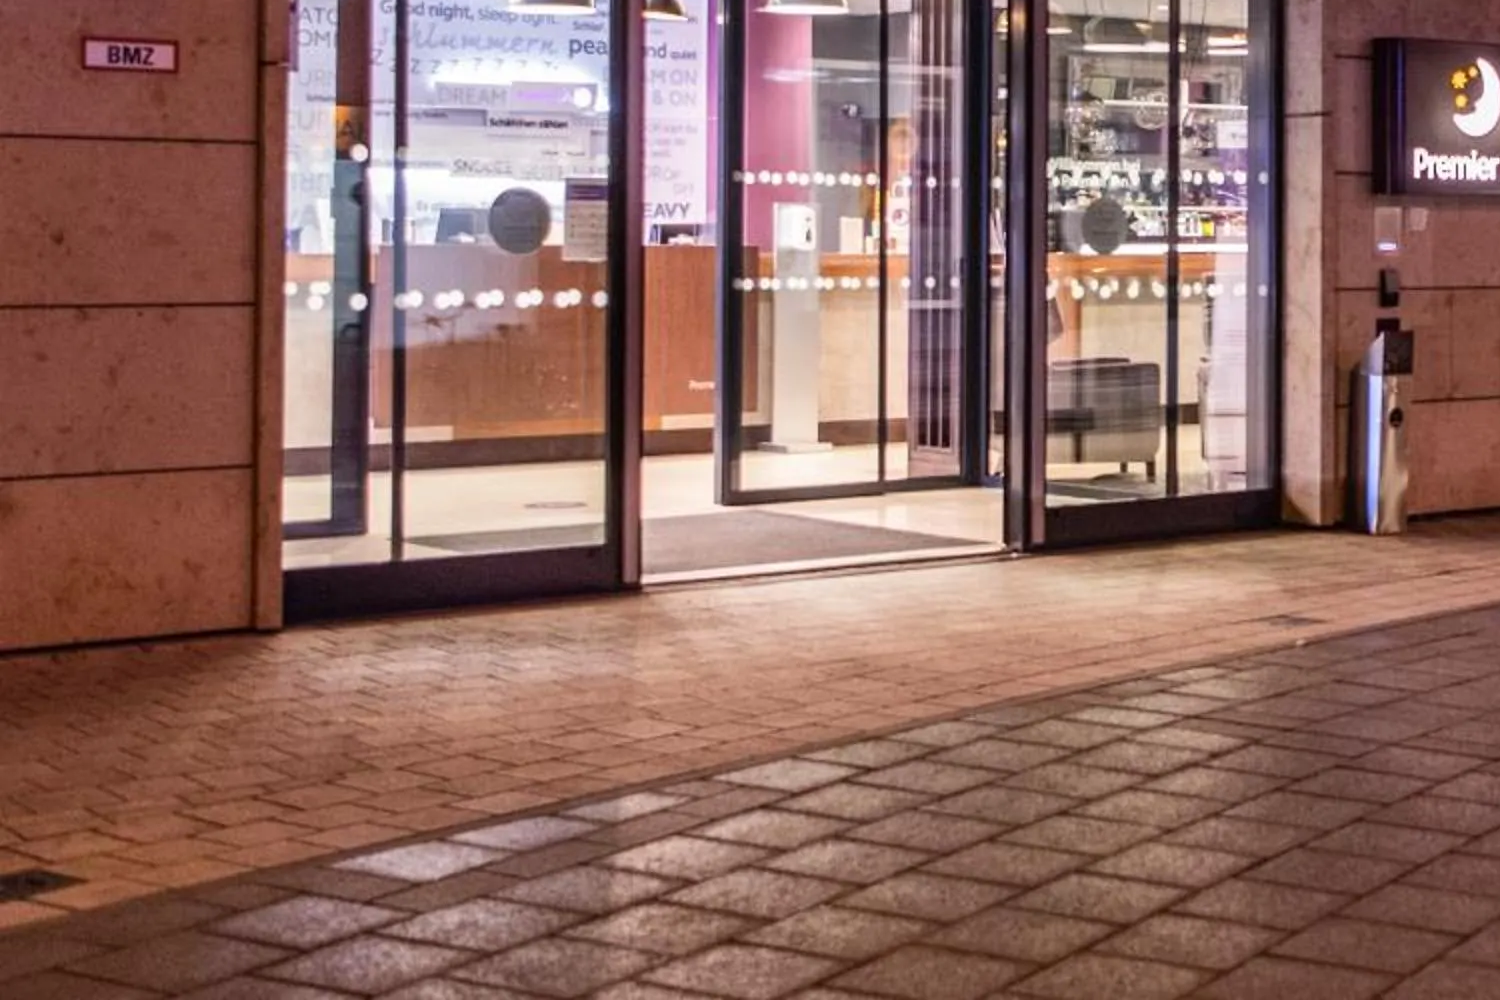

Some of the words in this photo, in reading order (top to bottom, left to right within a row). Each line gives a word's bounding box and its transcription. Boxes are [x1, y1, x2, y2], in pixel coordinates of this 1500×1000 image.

[429, 1, 474, 22] night,
[107, 45, 155, 66] BMZ
[1413, 147, 1500, 182] Premier
